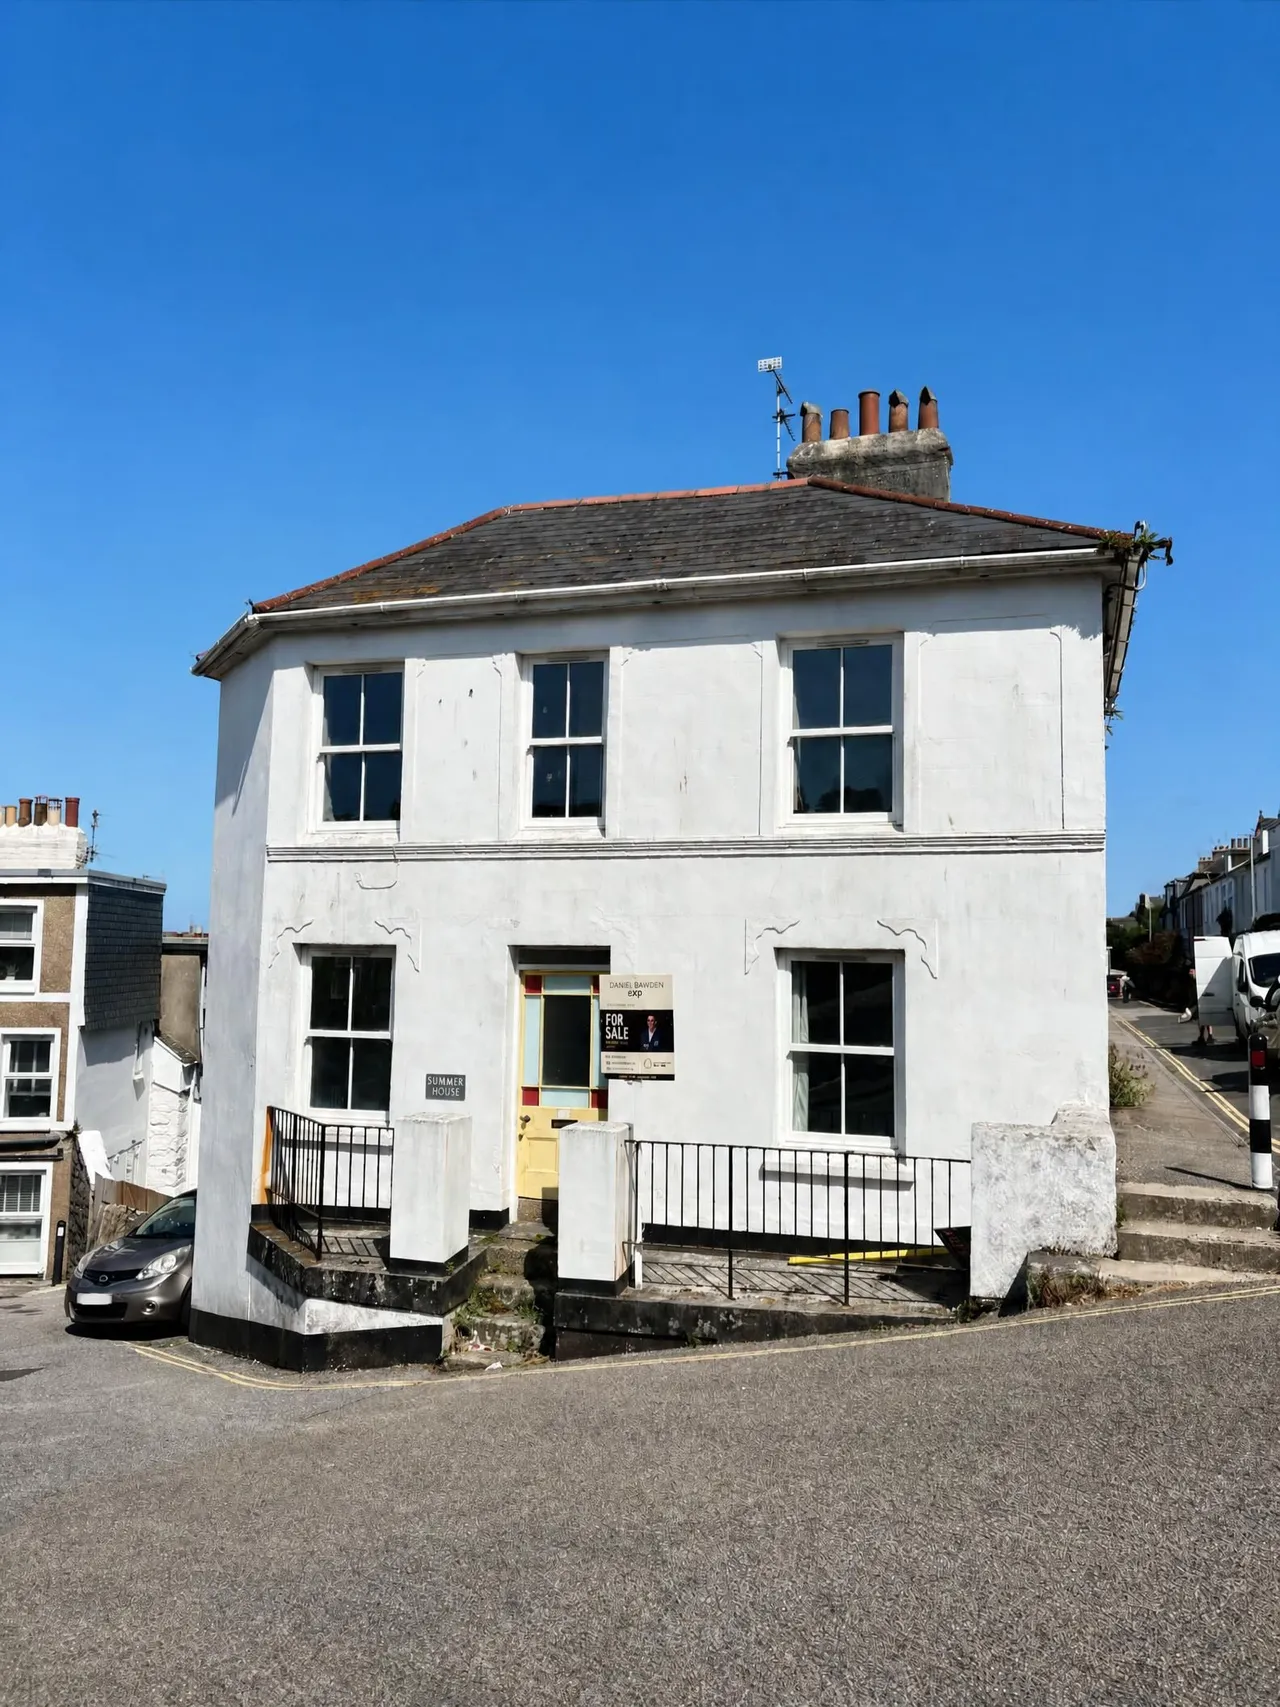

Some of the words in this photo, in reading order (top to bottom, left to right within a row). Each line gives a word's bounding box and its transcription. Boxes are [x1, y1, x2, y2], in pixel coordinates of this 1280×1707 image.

[609, 981, 632, 989] DANIEL
[634, 981, 664, 989] BAWDEN
[627, 989, 643, 999] exp
[605, 1013, 624, 1026] FOR
[605, 1026, 629, 1040] SALE
[427, 1076, 464, 1086] SUMMER
[432, 1087, 460, 1097] HOUSE
